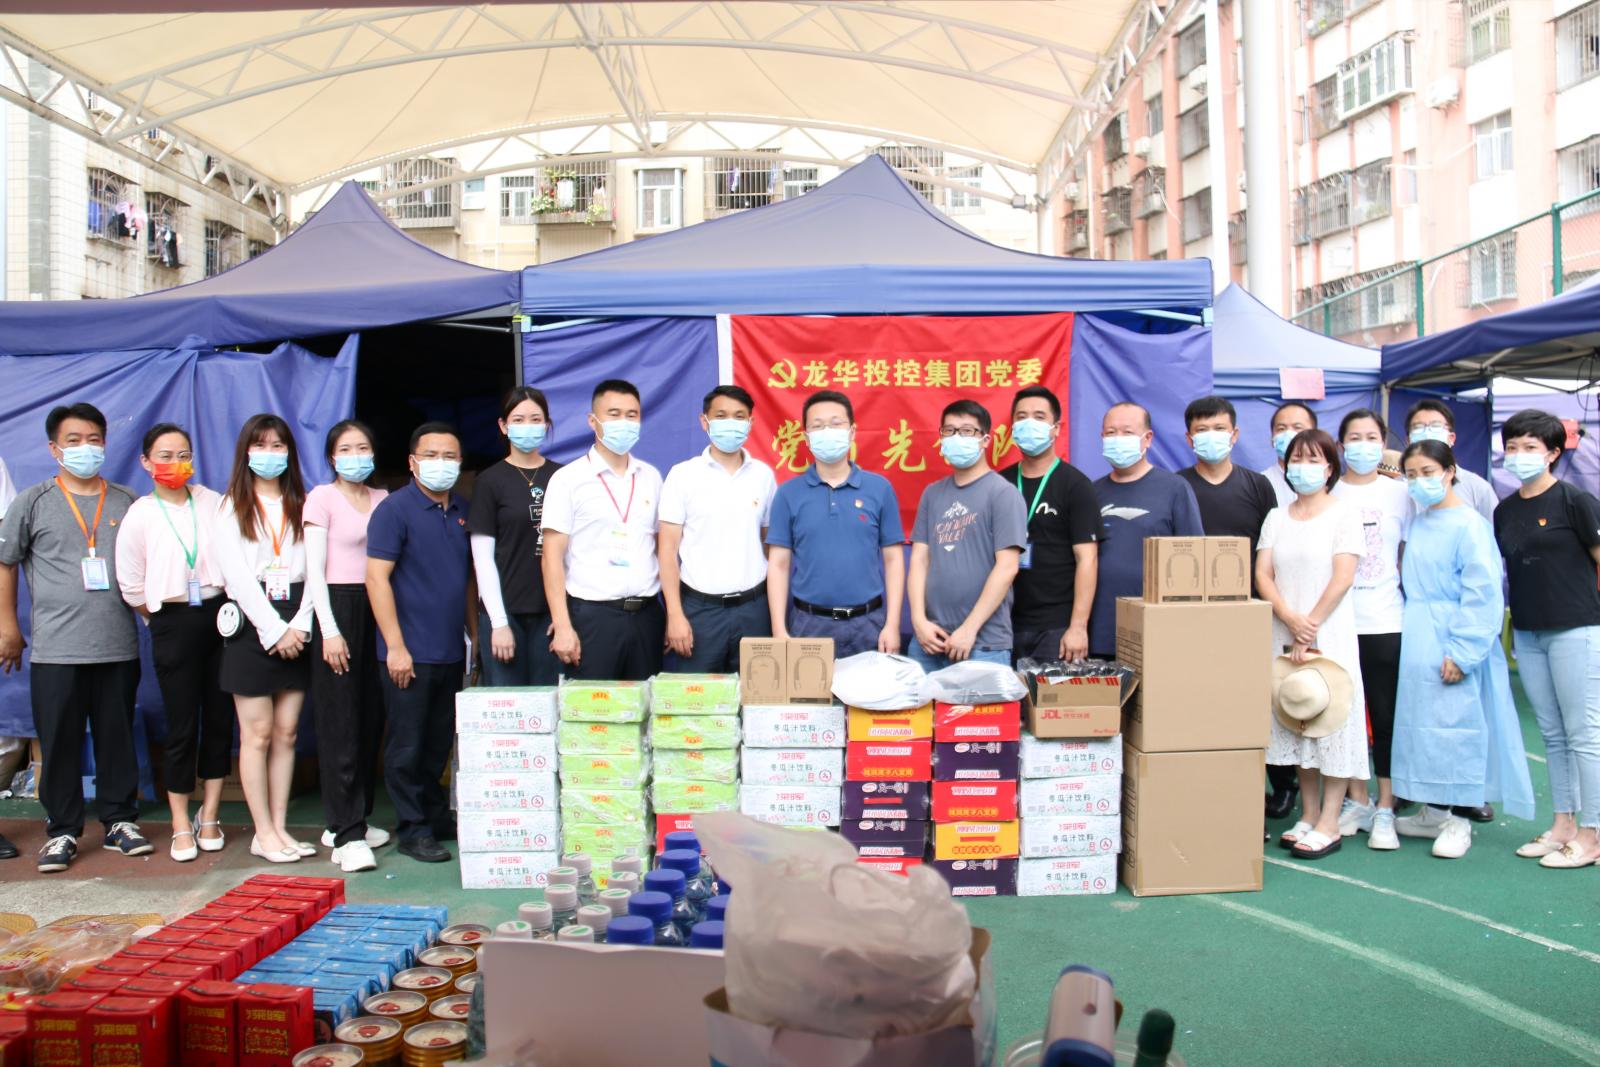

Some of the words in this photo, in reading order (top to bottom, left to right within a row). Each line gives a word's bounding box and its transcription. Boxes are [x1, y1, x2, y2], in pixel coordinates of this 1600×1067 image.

[802, 358, 1043, 389] 龙华投控集团党委
[1041, 709, 1062, 719] JDL
